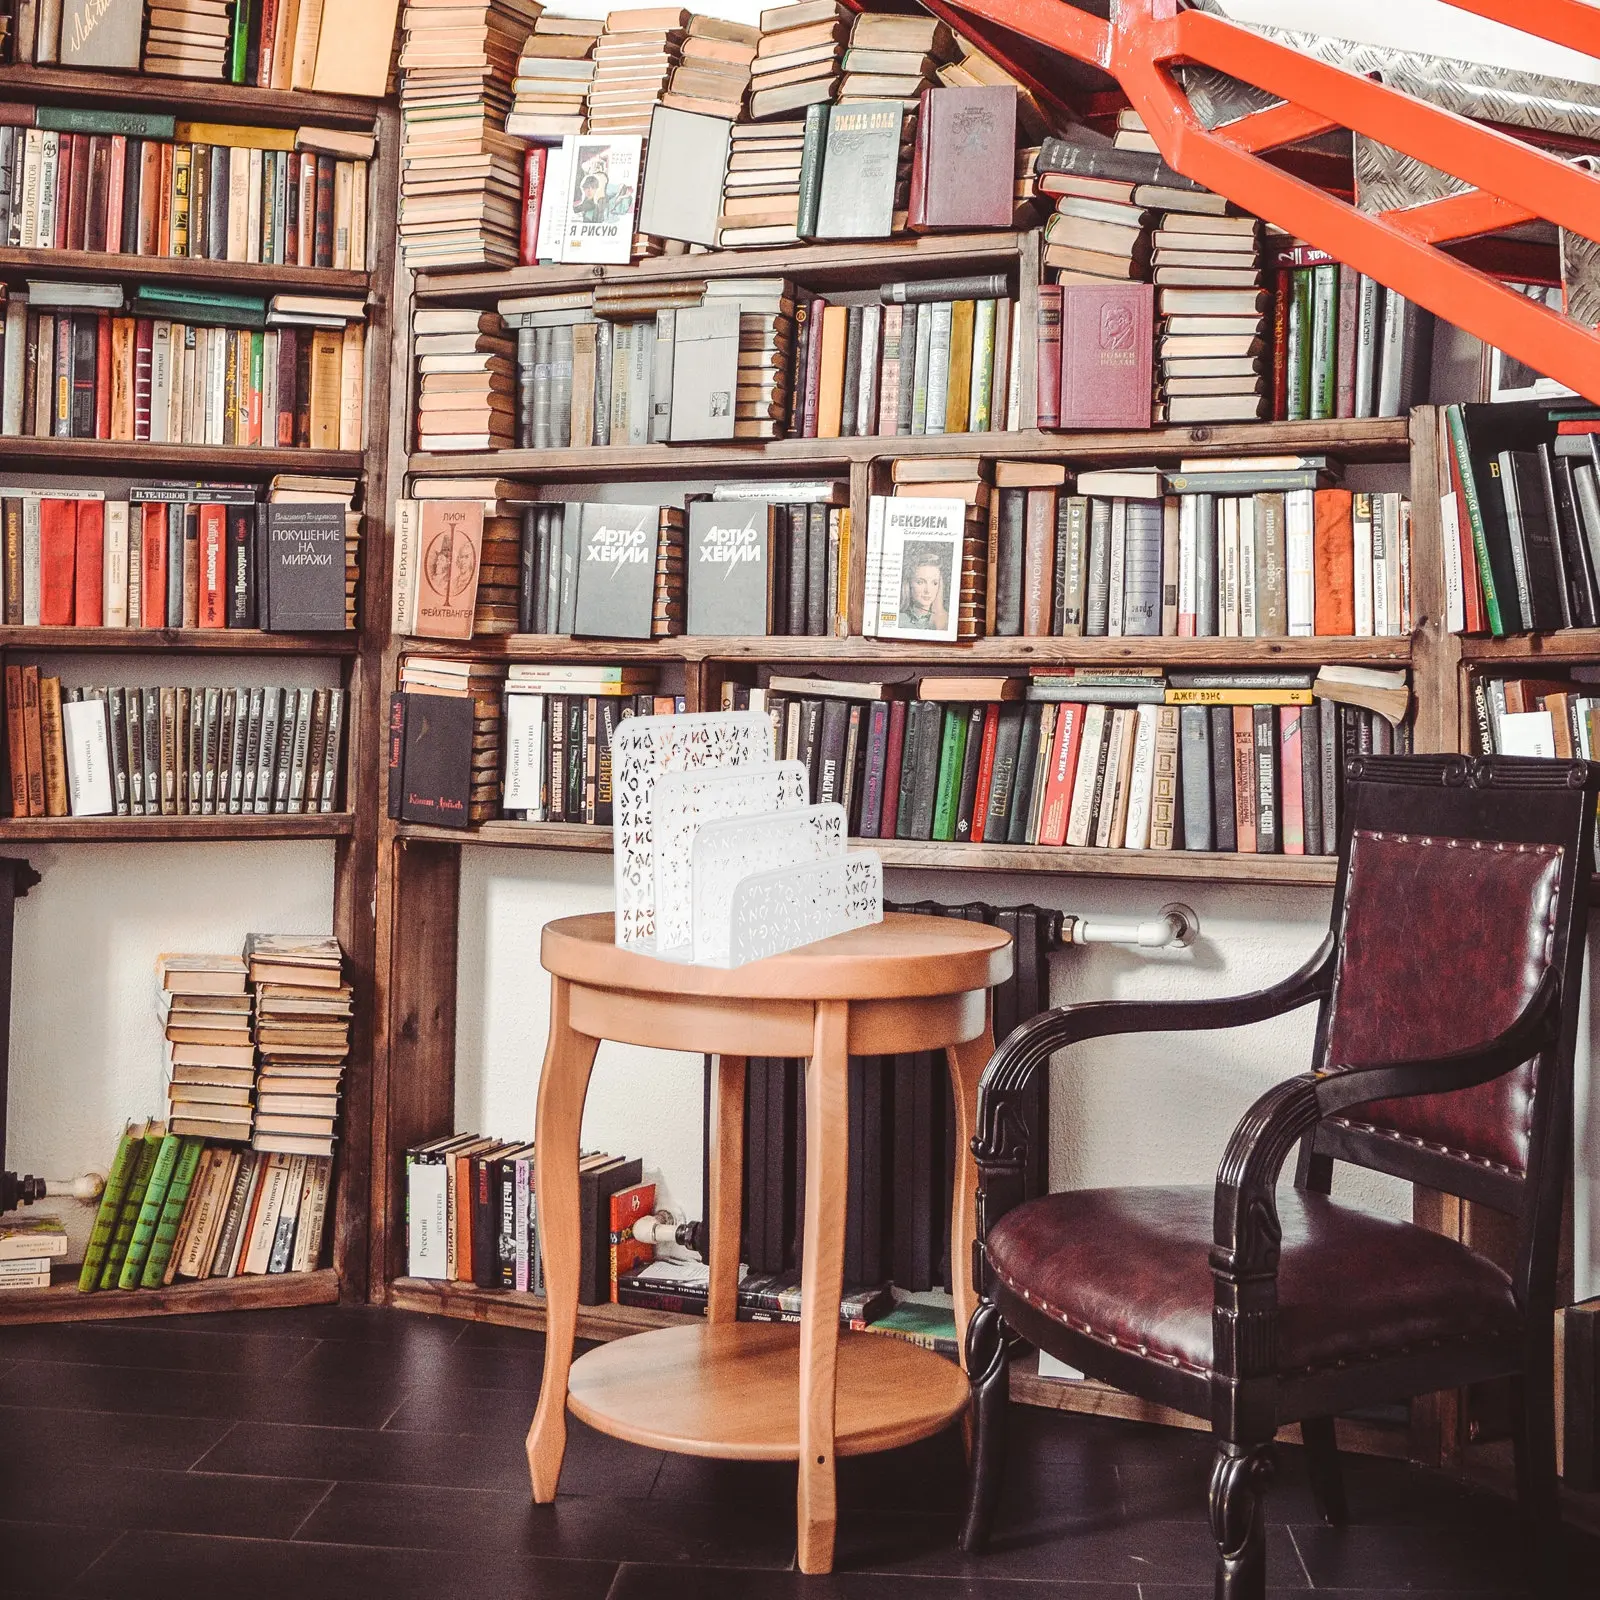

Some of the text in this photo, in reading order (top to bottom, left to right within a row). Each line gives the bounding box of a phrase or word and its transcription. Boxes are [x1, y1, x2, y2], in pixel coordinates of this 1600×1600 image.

[24, 164, 37, 245] ЧИНГИЗ АЙТМАТОВ
[569, 225, 618, 237] Я РИСУЮ
[1363, 285, 1373, 346] ОСКАР УАЙЛЬД
[135, 491, 186, 501] Н.ТЕЛЕШОВ
[442, 511, 466, 522] ЛИОН
[1372, 498, 1382, 525] НИКТО
[8, 512, 18, 559] СИМОНОВ
[272, 529, 340, 542] ПОКУШЕНИЕ
[890, 514, 948, 528] РЕКВИЕМ
[1373, 525, 1384, 558] ДОКТОР
[1455, 438, 1494, 600] Вологодчина на рубеже веков
[235, 545, 247, 593] Проскурин
[281, 553, 333, 566] МИРАЖИ
[298, 541, 315, 553] НА
[1031, 547, 1043, 602] АНАТОЛИЙ
[398, 592, 406, 622] ЛИОН
[420, 606, 474, 619] ФЕЙХТВАНГЕР
[1173, 691, 1198, 701] ДЖЕК
[1200, 691, 1221, 700] ВЭНС
[1475, 685, 1488, 730] И ЖИЗНЬ
[235, 743, 244, 768] ПЕТРУ
[247, 718, 258, 767] ЧИЧЕРИН
[261, 719, 275, 769] КОММУНИСТЫ
[279, 719, 292, 770] ГОНЧАРОВ
[295, 719, 307, 769] ВАШИНГТОН
[312, 720, 322, 767] ФОЛКНЕР
[327, 729, 336, 766] ЛАВРОВ
[527, 724, 535, 769] детектив
[1057, 709, 1074, 783] Ф.НЕЗНАНСКИЙ
[1346, 730, 1356, 747] АД
[84, 739, 98, 784] интересных
[510, 738, 521, 799] Зарубежный
[598, 745, 612, 803] МАСТЕРА
[823, 759, 836, 793] КРИСТИ
[1092, 741, 1108, 818] ЗАРУБЕЖНЫЙ ДЕТЕКТИВ
[72, 774, 82, 801] Жизнь
[1259, 752, 1274, 835] ЦЕЛЬ-ПРЕЗИДЕНТ
[232, 1164, 251, 1206] ГАЙДАР
[262, 1171, 282, 1227] Три мушкетера
[503, 1181, 513, 1234] ПРЕДТЕЧИ
[419, 1218, 430, 1257] Русский
